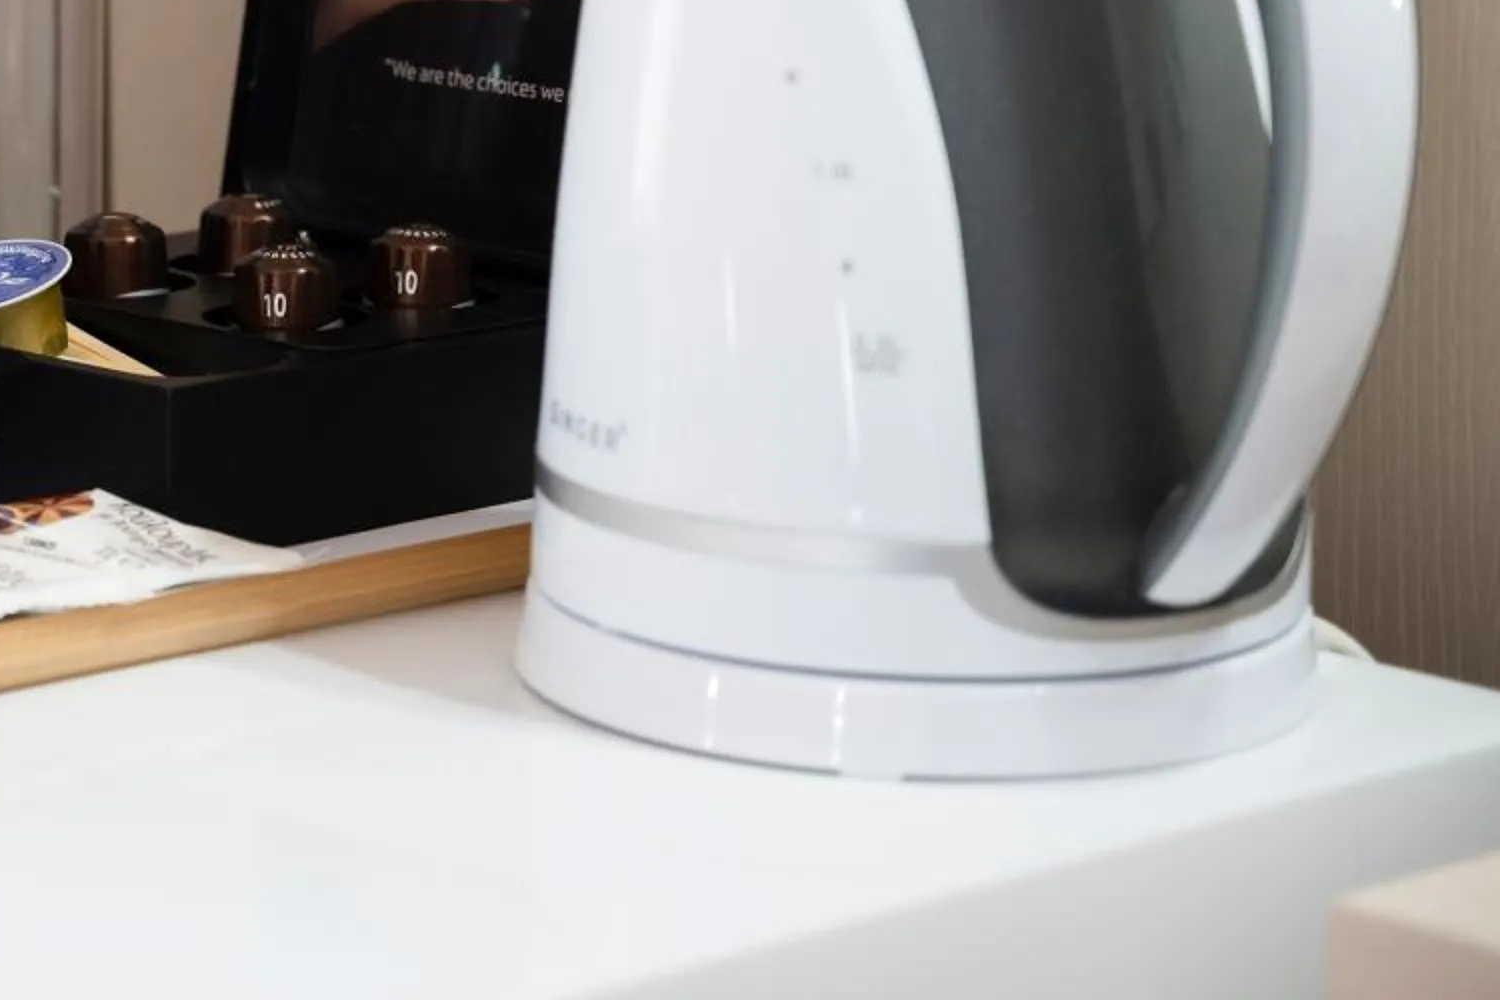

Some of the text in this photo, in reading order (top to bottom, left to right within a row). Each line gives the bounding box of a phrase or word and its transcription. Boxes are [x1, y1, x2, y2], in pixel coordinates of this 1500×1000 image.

[420, 66, 445, 86] are
[447, 68, 475, 91] the
[477, 73, 538, 99] choices
[540, 85, 565, 103] we
[392, 268, 420, 297] 10
[262, 292, 289, 320] 10
